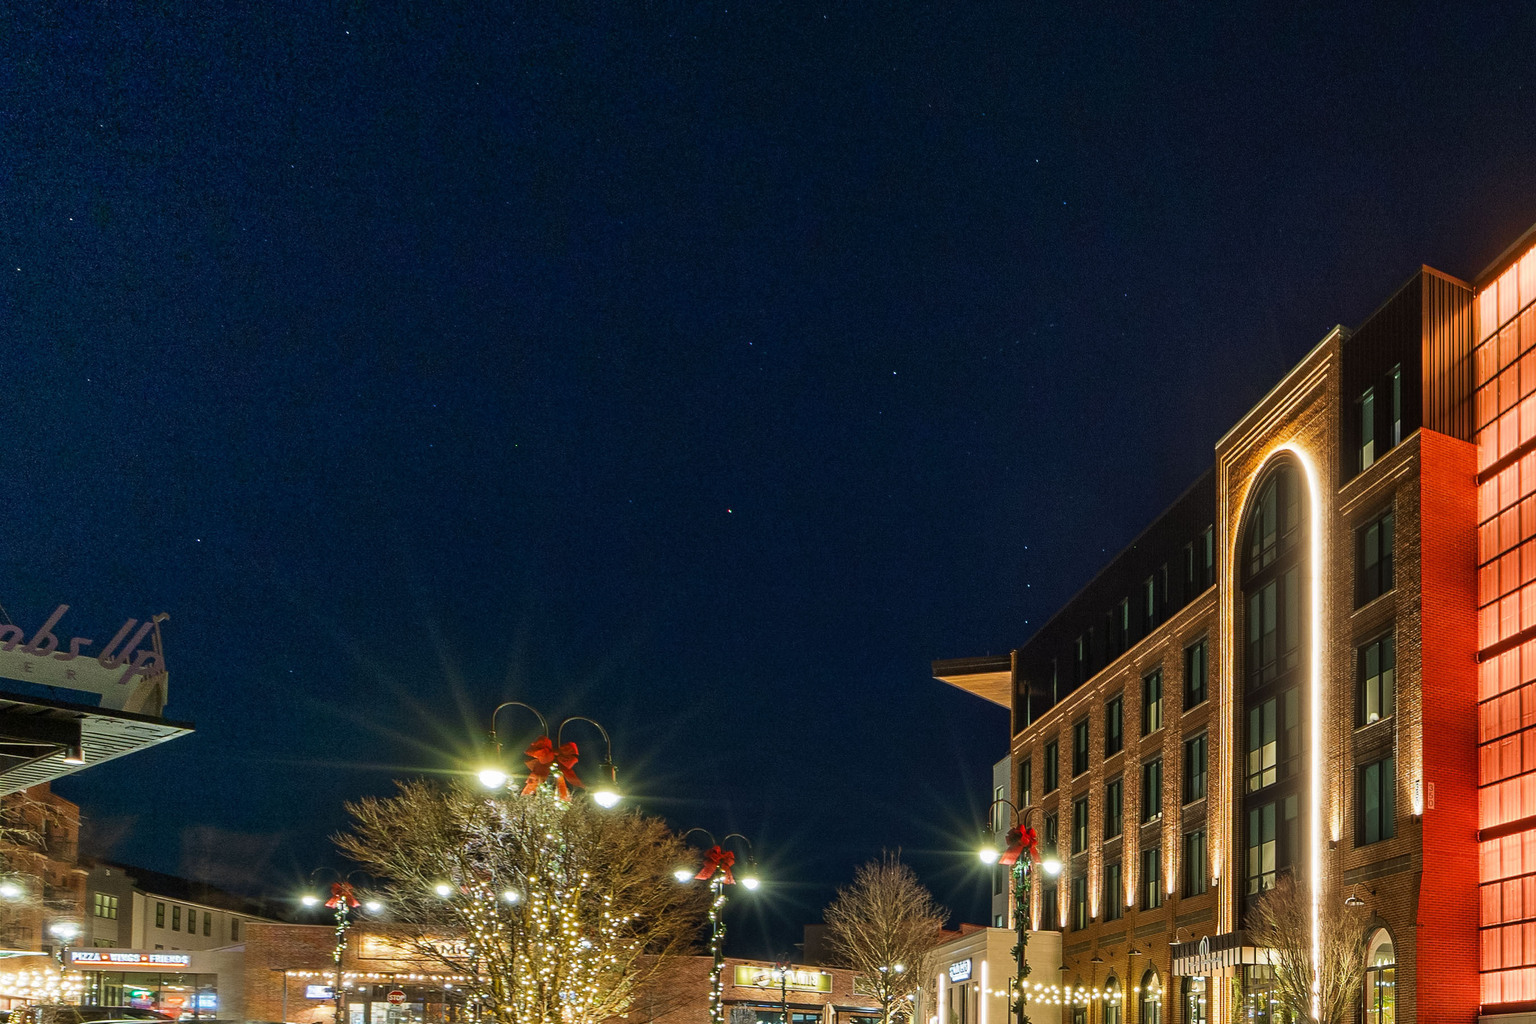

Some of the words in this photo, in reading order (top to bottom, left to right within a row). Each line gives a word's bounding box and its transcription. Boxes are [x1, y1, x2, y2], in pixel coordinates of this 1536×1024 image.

[98, 618, 166, 685] Up
[71, 952, 101, 961] PIZZA
[149, 954, 189, 964] FRIENDS
